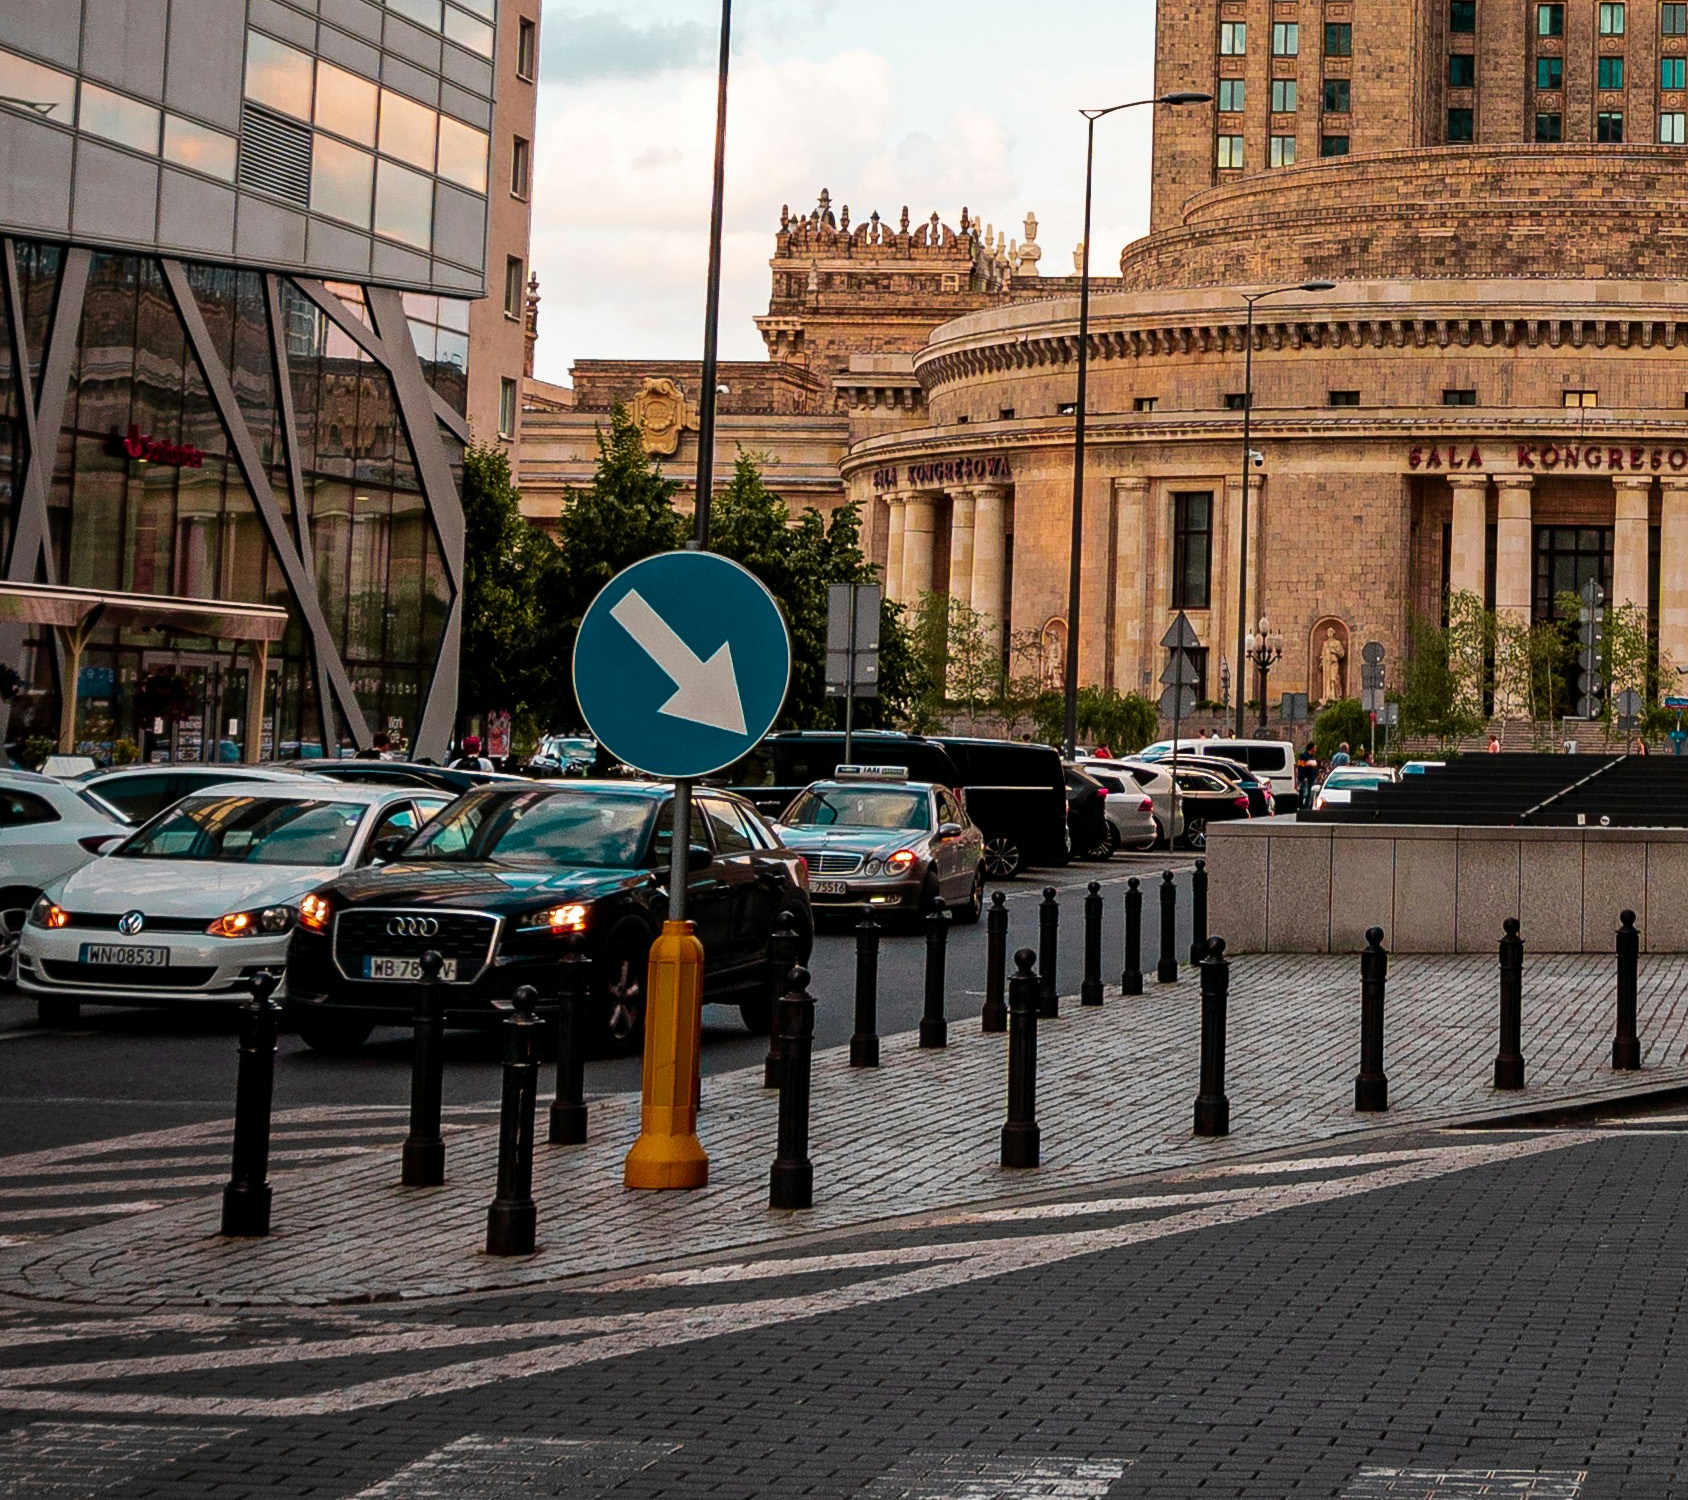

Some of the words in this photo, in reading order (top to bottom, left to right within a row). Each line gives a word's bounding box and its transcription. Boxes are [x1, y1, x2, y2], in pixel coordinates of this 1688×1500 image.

[1409, 445, 1483, 469] SALA
[89, 947, 112, 963] WN
[116, 948, 165, 965] 0853J
[374, 959, 394, 977] WB
[400, 961, 452, 978] 78V
